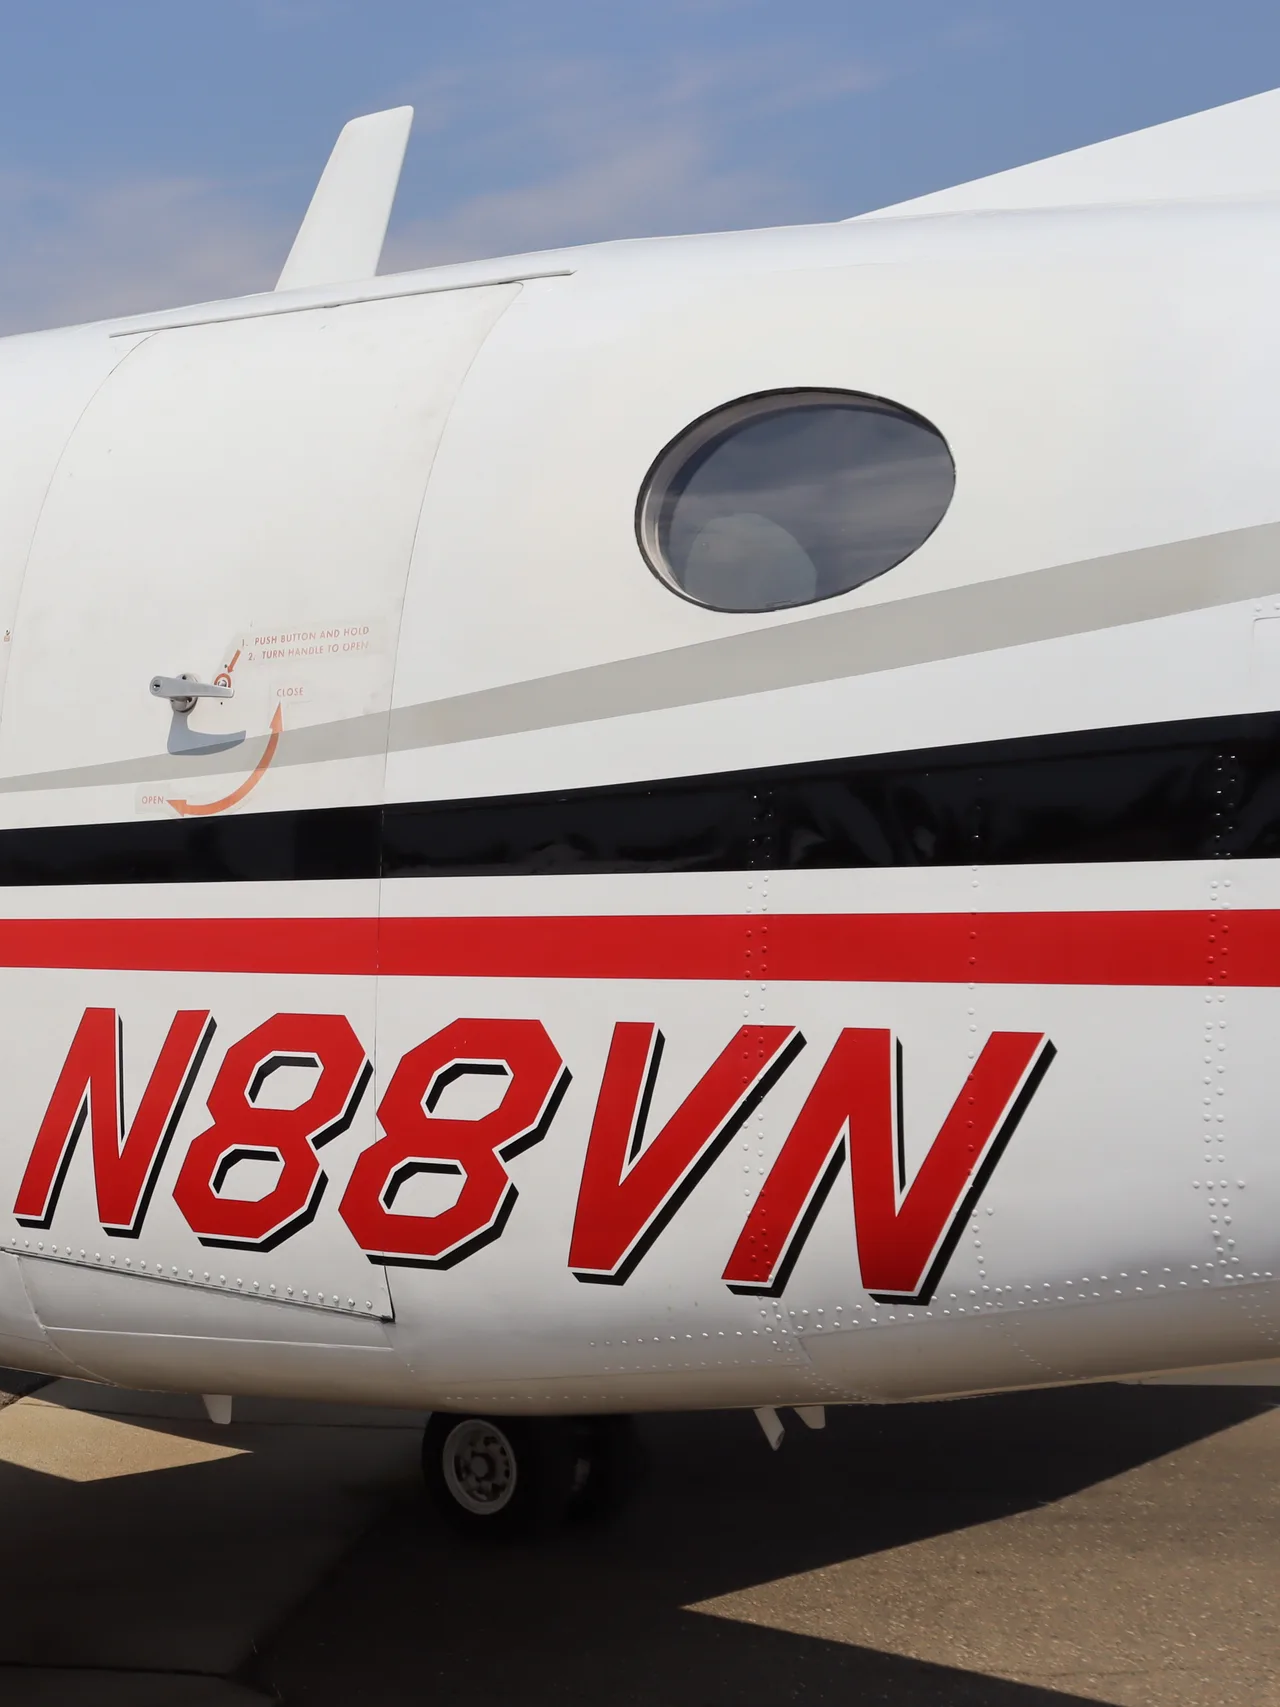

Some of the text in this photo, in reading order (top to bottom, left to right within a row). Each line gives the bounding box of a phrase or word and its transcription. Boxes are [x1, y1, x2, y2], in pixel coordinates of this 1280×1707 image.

[254, 635, 278, 646] PUSH
[280, 632, 317, 643] BUTTON
[320, 629, 340, 639] AND
[343, 626, 370, 637] HOLD
[248, 641, 370, 661] 2. TURN HANDLE TO OPEN
[276, 686, 304, 697] CLOSE
[141, 795, 164, 805] OPEN
[12, 1007, 1058, 1306] N88VN
